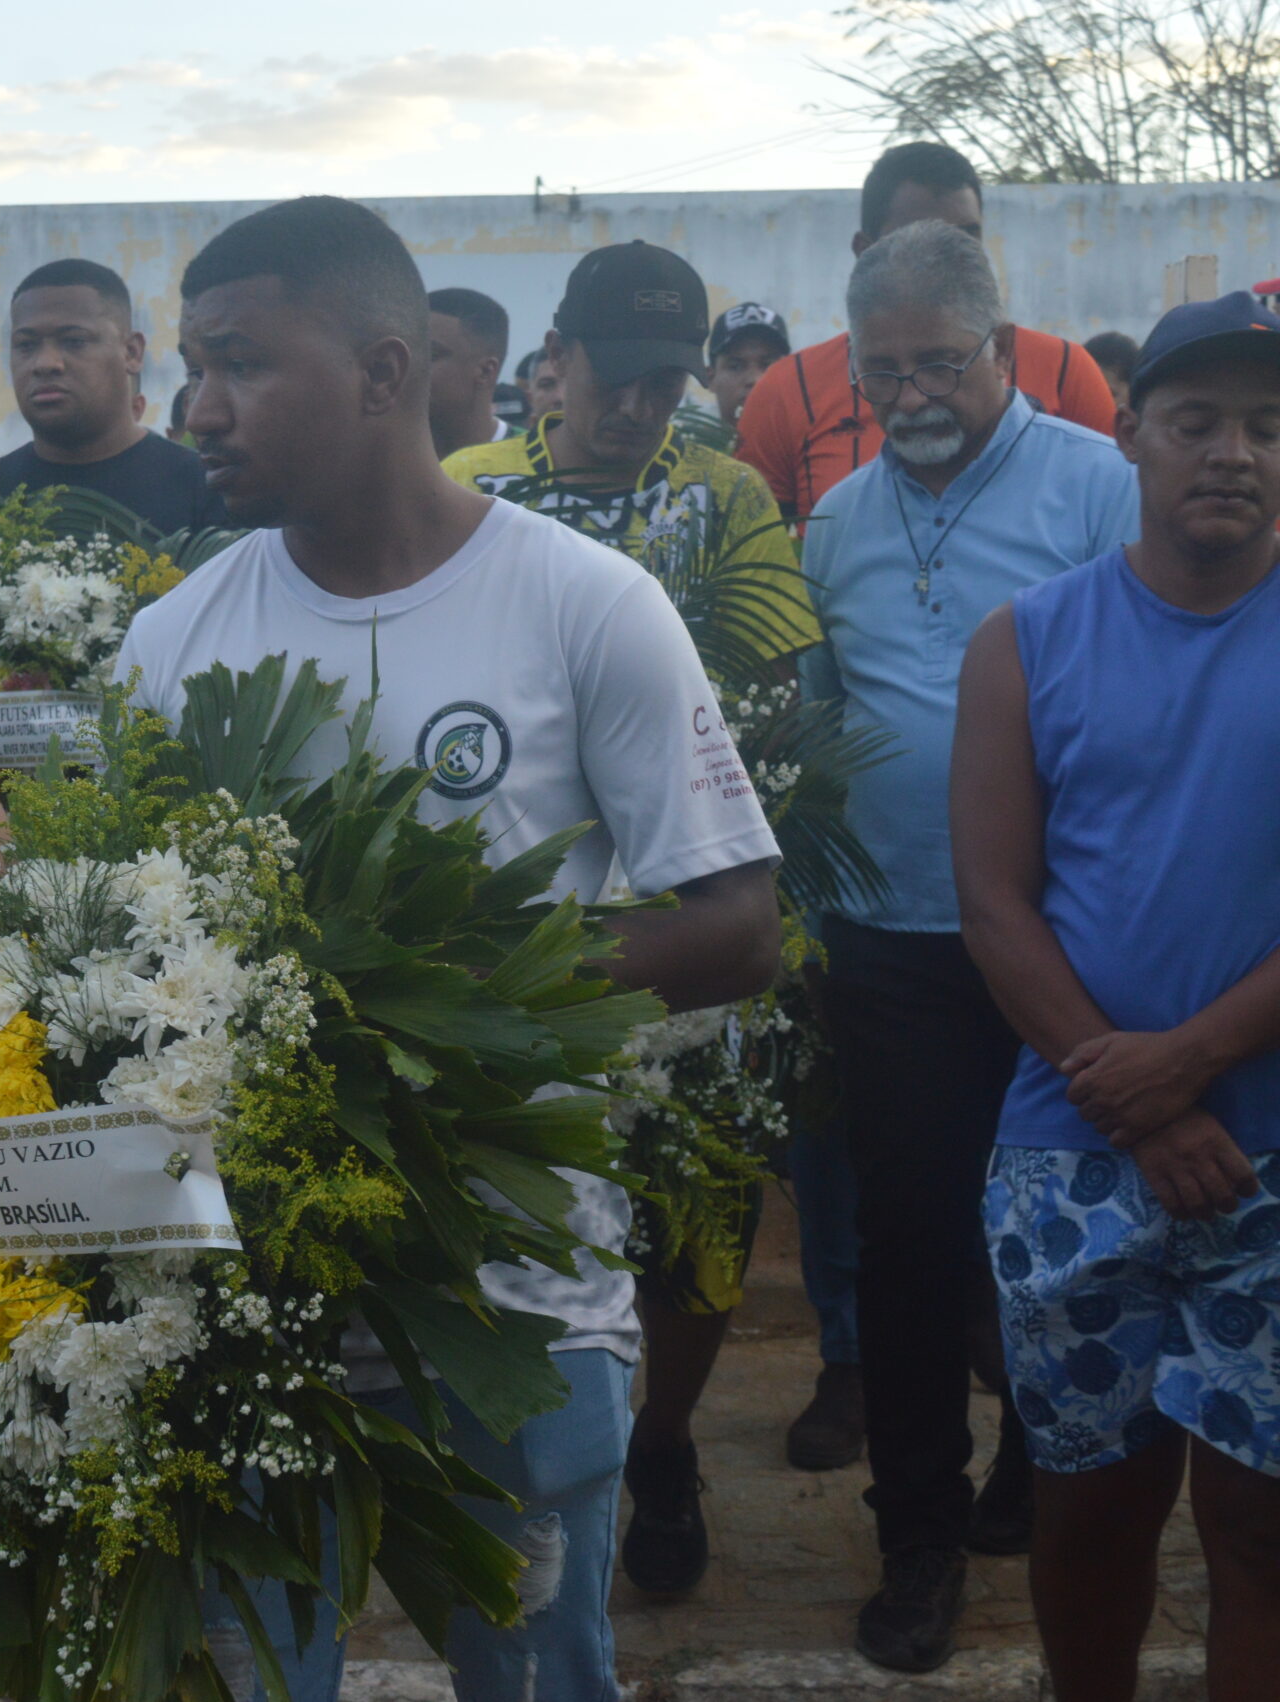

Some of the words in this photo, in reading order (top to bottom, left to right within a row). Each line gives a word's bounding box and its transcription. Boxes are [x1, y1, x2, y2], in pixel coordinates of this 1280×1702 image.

[726, 306, 774, 331] EA7
[0, 705, 43, 722] FUTSAL
[47, 704, 62, 719] TE
[713, 775, 721, 786] 9
[11, 1139, 95, 1164] VAZIO
[0, 1198, 90, 1226] BRASÍLIA.
